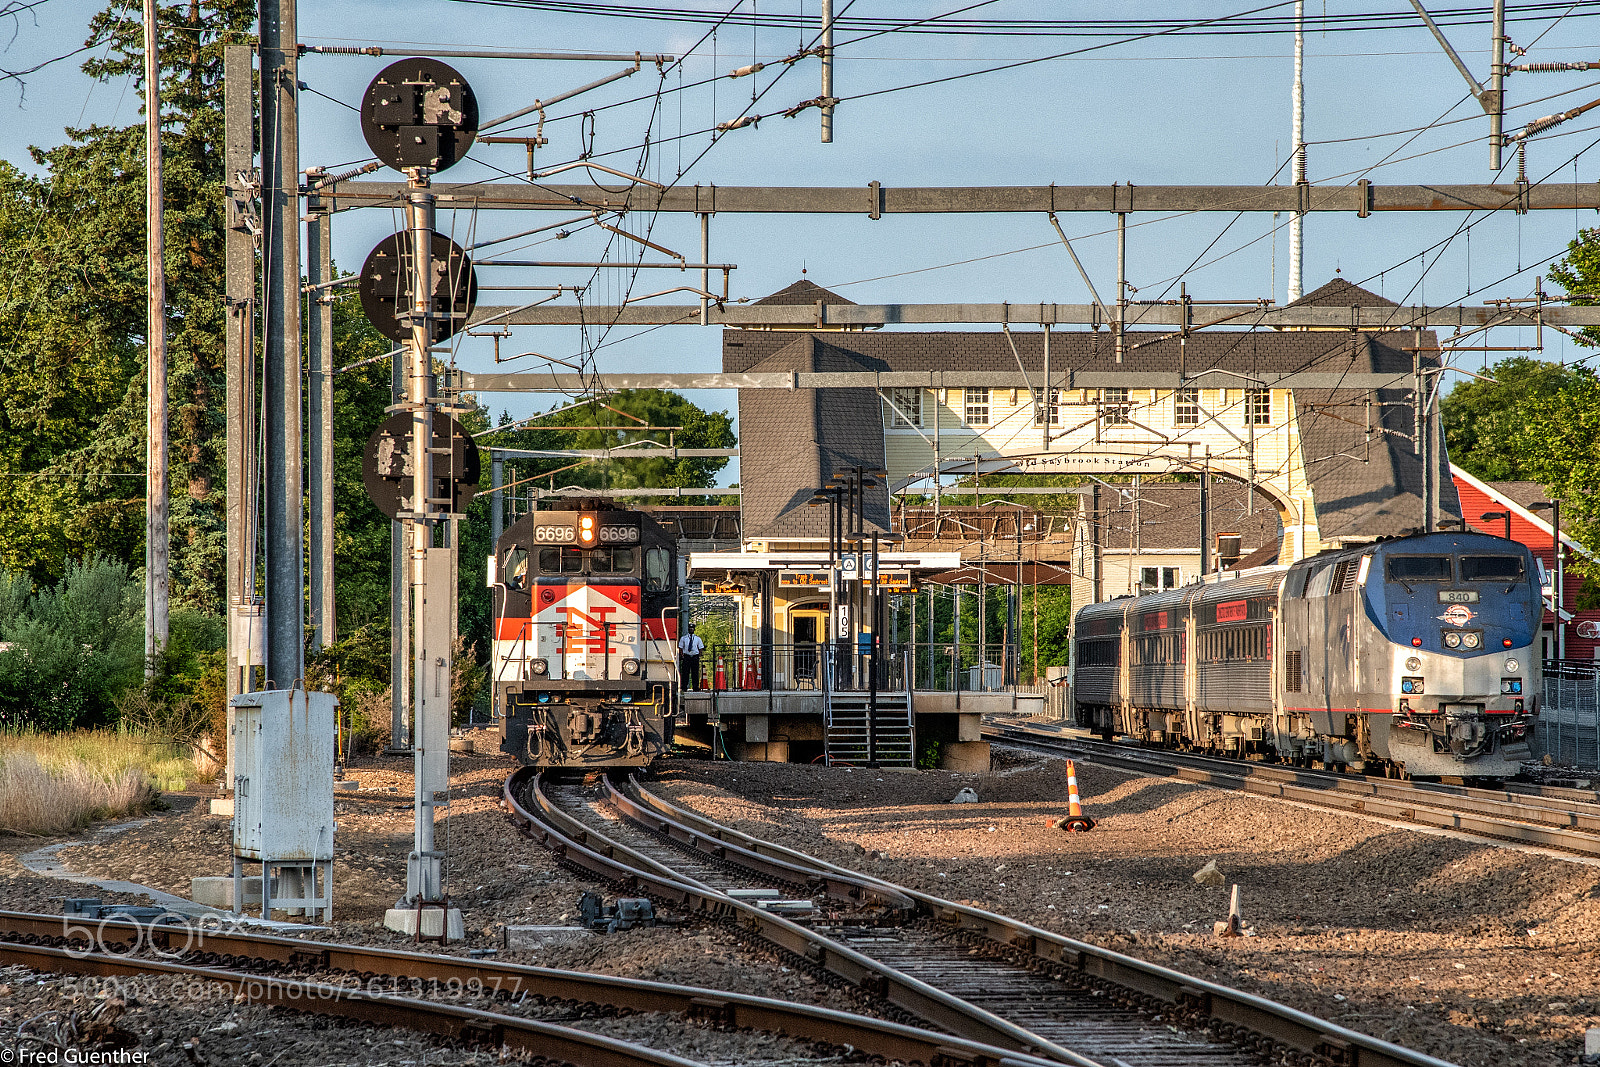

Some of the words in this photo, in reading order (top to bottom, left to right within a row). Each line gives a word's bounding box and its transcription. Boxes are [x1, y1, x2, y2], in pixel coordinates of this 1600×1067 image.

[1041, 457, 1099, 466] Saybrook
[535, 527, 574, 541] 6696
[599, 527, 637, 541] 6696
[1448, 592, 1470, 602] 840
